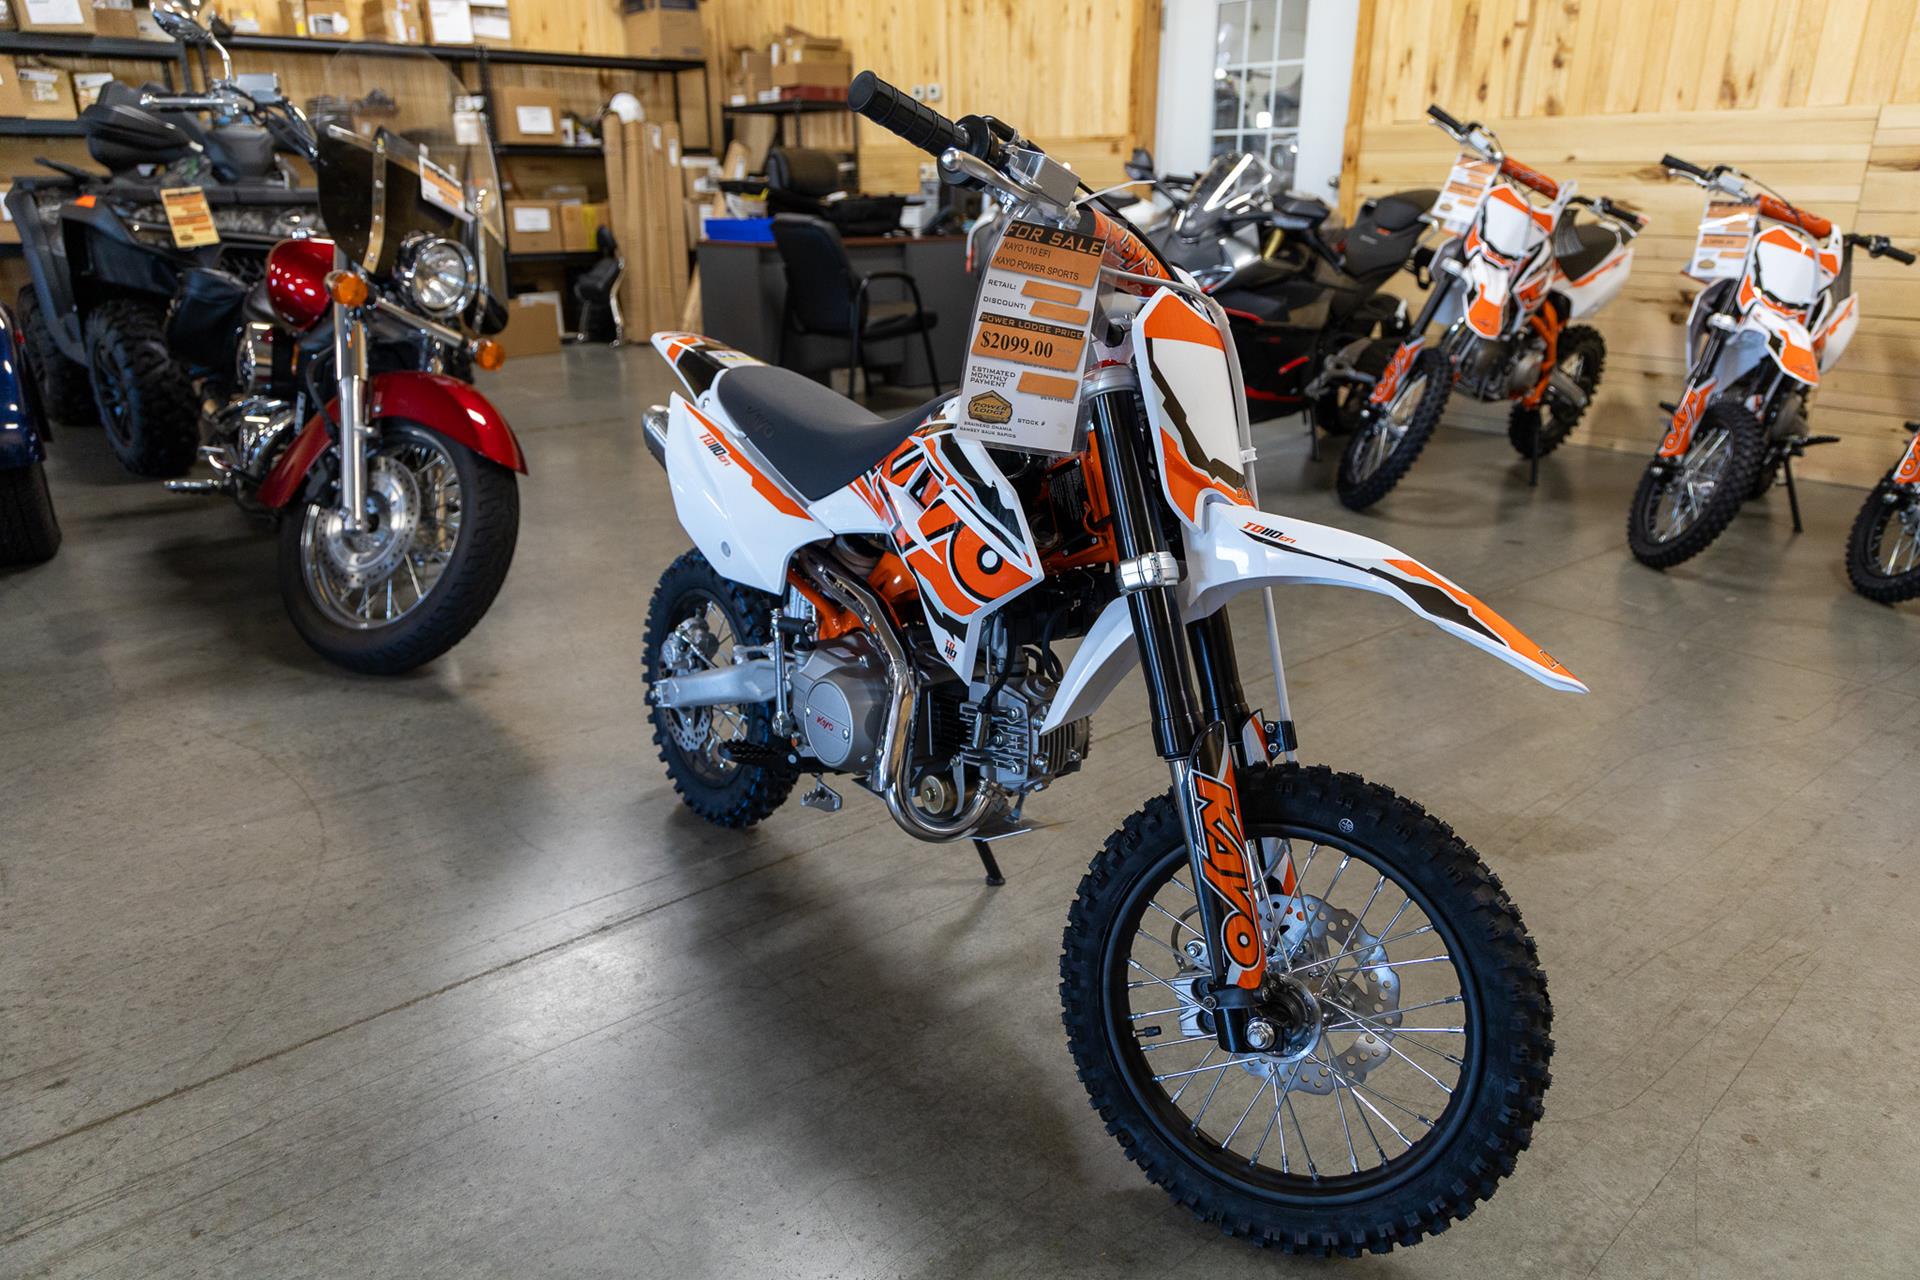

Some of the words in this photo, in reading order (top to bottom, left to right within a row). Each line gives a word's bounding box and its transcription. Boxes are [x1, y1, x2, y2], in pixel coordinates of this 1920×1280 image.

[1004, 222, 1045, 243] FOR
[1048, 231, 1105, 257] SALE
[1003, 241, 1025, 253] KAYO
[1025, 245, 1038, 256] 110
[1038, 248, 1051, 259] EFI
[995, 256, 1017, 268] KAYO
[1016, 260, 1047, 273] POWER
[1047, 266, 1080, 281] SPORTS
[987, 279, 1017, 290] RETAIL:
[982, 295, 1027, 310] DISCOUNT:
[980, 313, 1015, 327] POWER
[1018, 321, 1052, 334] LODGE
[1054, 327, 1083, 340] PRICE
[980, 330, 1054, 359] $2099.00
[970, 371, 1009, 383] MONTHLY
[971, 365, 1017, 379] ESTIMATED
[969, 377, 1007, 388] PAYMENT
[972, 402, 1009, 412] POWER
[973, 406, 1006, 416] LODGE
[1017, 417, 1040, 427] STOCK
[1189, 769, 1263, 972] KAYO
